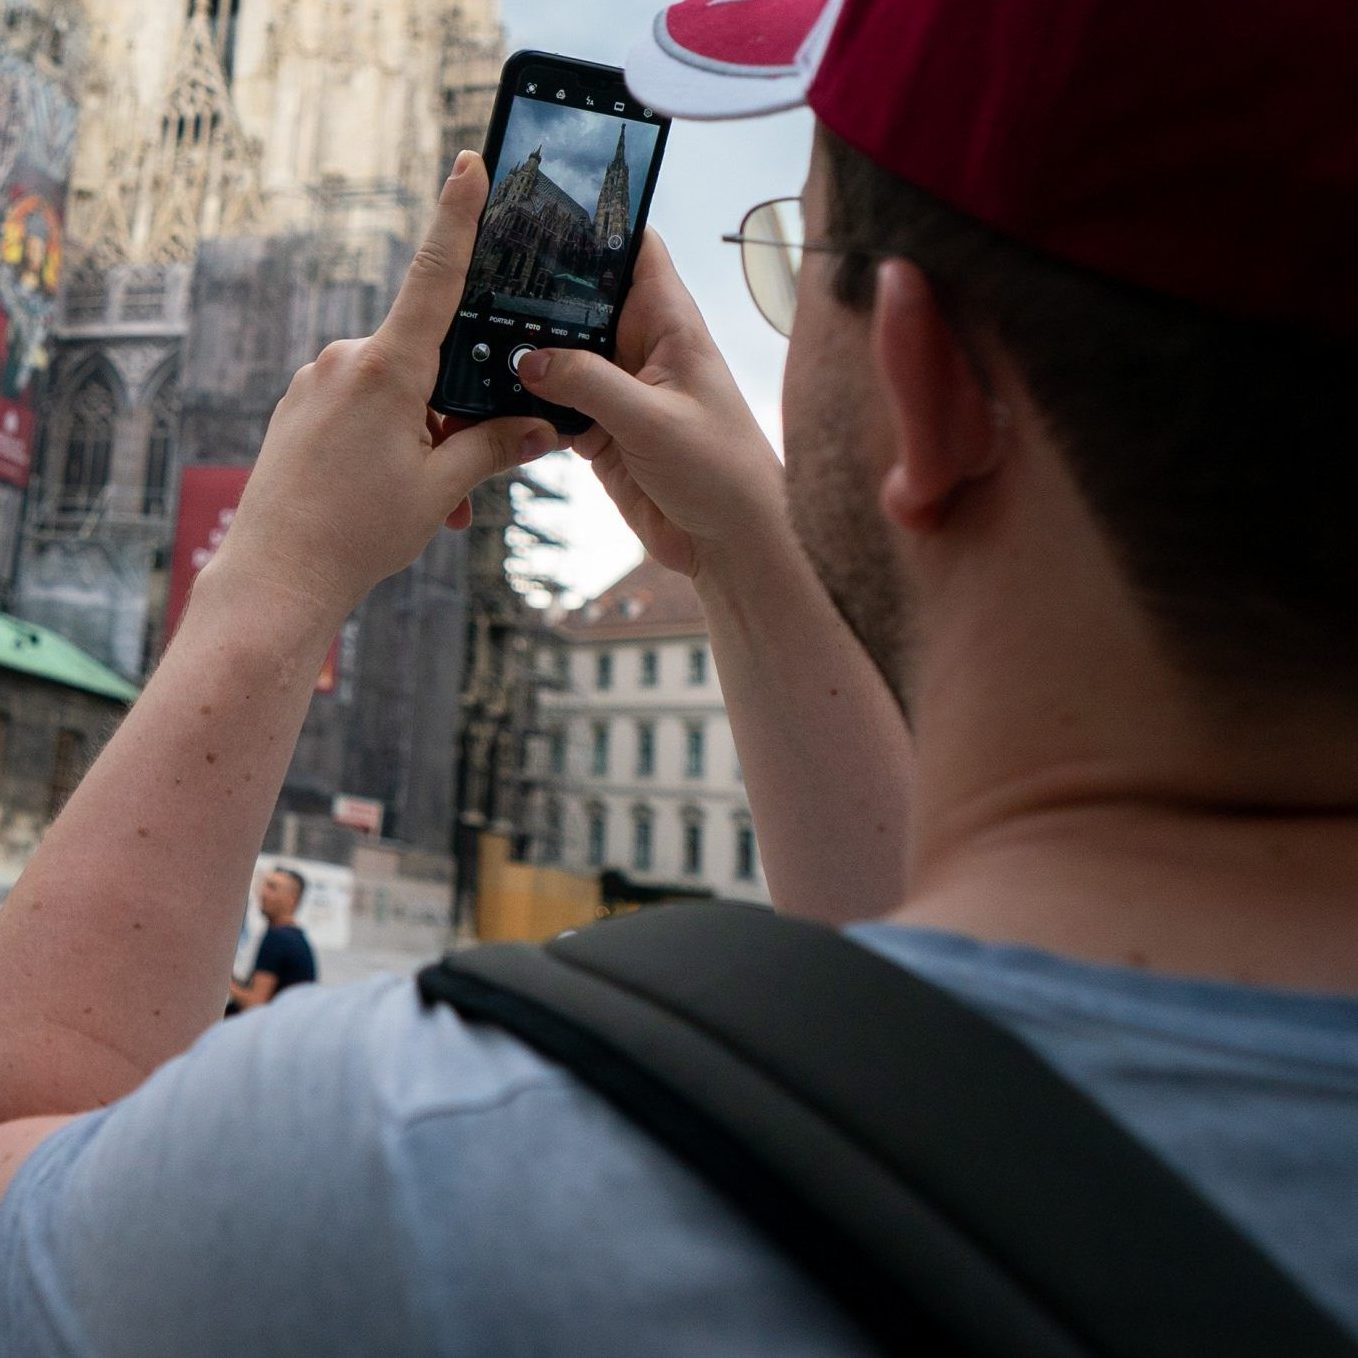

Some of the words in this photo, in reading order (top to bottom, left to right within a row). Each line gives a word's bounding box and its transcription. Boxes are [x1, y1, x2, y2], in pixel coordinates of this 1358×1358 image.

[525, 322, 541, 331] FOTO
[551, 327, 568, 336] VIDEO
[578, 332, 590, 341] PRO
